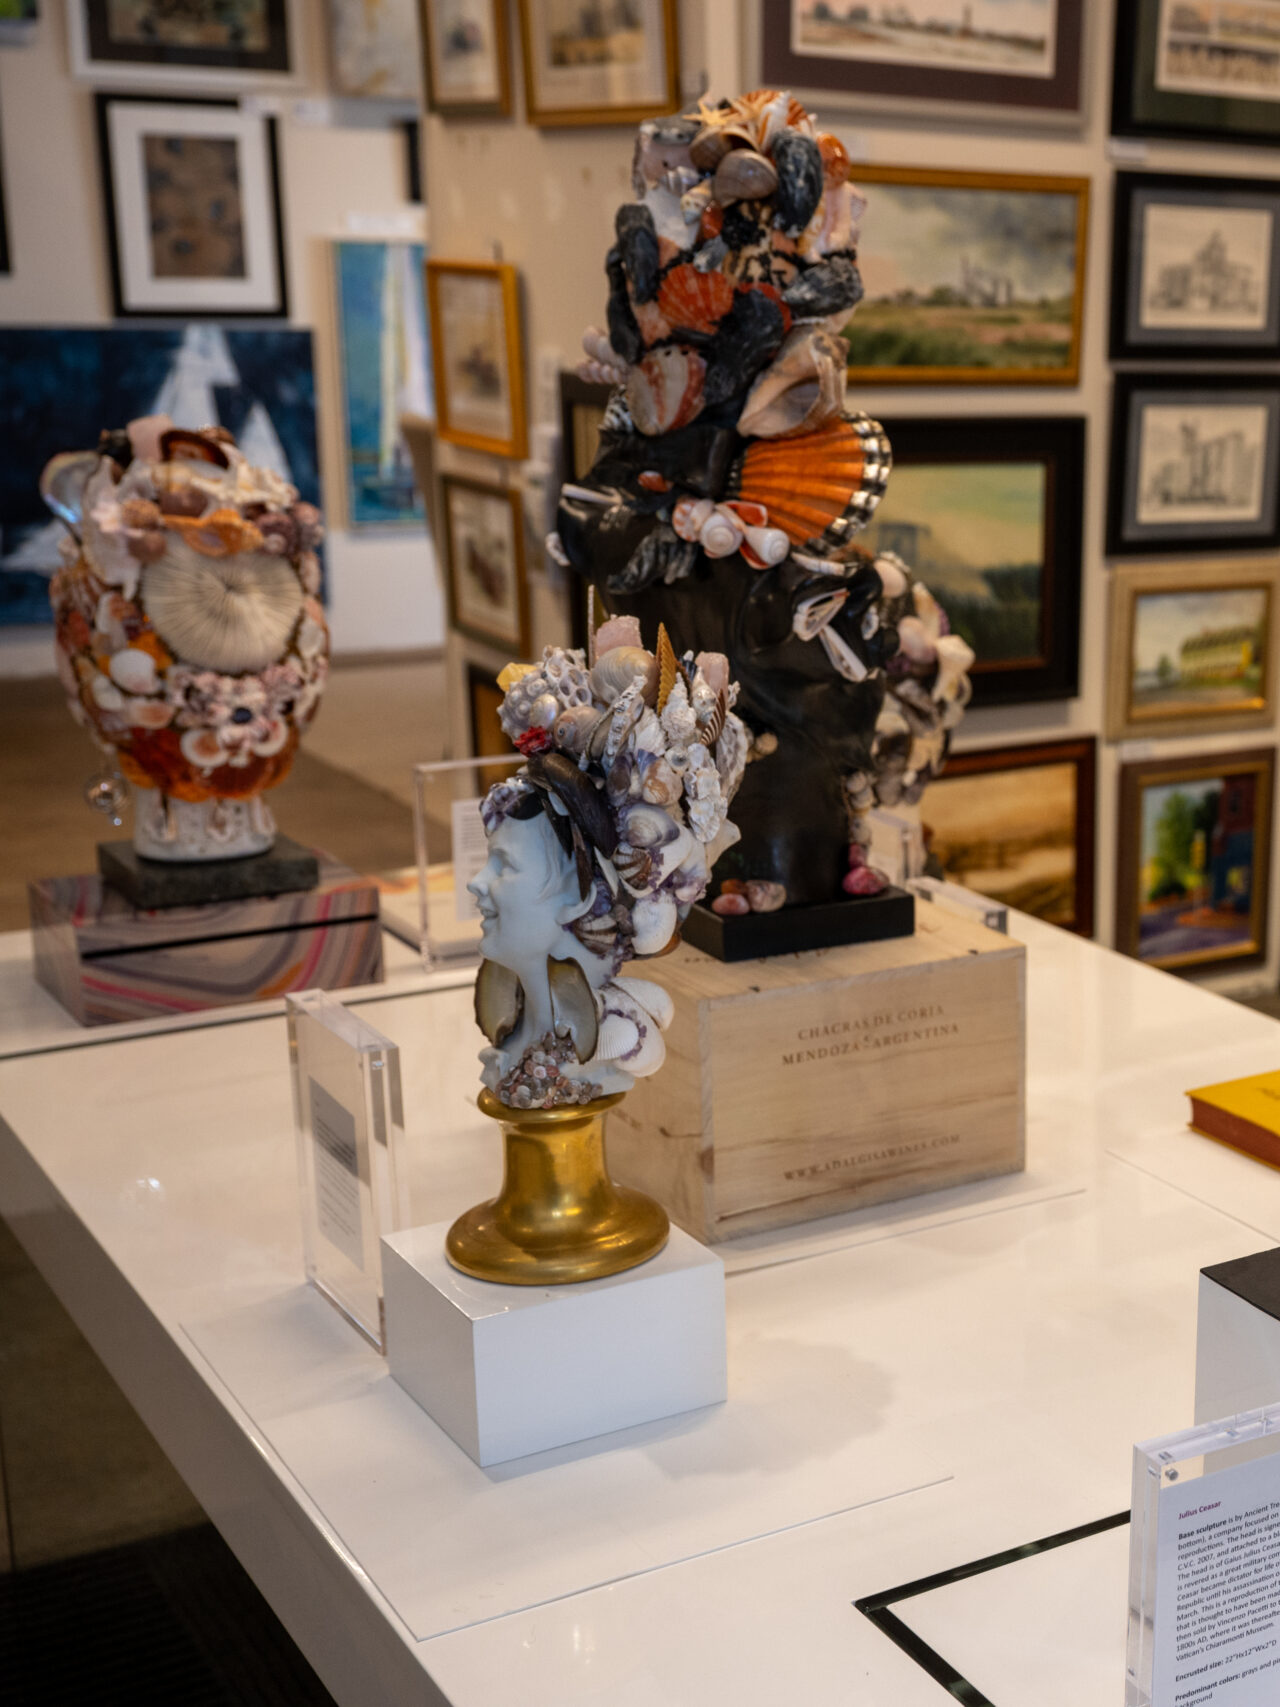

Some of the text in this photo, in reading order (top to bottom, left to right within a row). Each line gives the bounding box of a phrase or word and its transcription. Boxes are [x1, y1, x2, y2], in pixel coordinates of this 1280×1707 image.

[797, 1017, 870, 1041] CHACRAS
[873, 1013, 893, 1027] DE
[782, 1023, 959, 1066] MENDOZA ARGENTINA
[1178, 1500, 1222, 1520] Julius Ceasar
[1178, 1530, 1195, 1541] Base
[1195, 1519, 1227, 1535] sculpture
[1243, 1505, 1269, 1519] Ancient
[1213, 1524, 1244, 1539] company
[1244, 1513, 1270, 1529] focused
[1216, 1547, 1230, 1558] and
[1230, 1537, 1259, 1554] attached
[1226, 1535, 1240, 1544] The
[1239, 1527, 1257, 1540] head
[1176, 1589, 1200, 1602] Ceasar
[1200, 1580, 1227, 1594] became
[1227, 1570, 1253, 1584] dictator
[1253, 1566, 1264, 1575] for
[1264, 1562, 1275, 1572] life
[1177, 1572, 1191, 1582] The
[1191, 1564, 1208, 1577] head
[1223, 1554, 1243, 1566] Gaius
[1243, 1548, 1261, 1560] Julius
[1183, 1574, 1210, 1589] revered
[1224, 1564, 1242, 1577] great
[1242, 1555, 1268, 1569] military
[1176, 1597, 1205, 1612] Republic
[1205, 1590, 1222, 1602] until
[1221, 1587, 1232, 1596] his
[1232, 1573, 1275, 1592] assassination
[1201, 1604, 1215, 1614] This
[1227, 1584, 1269, 1604] reproduction
[1175, 1632, 1192, 1643] then
[1192, 1624, 1207, 1637] sold
[1216, 1612, 1247, 1627] Vincenzo
[1247, 1603, 1269, 1617] Pacetti
[1176, 1621, 1191, 1632] that
[1197, 1610, 1224, 1625] thought
[1233, 1601, 1249, 1612] have
[1249, 1595, 1267, 1606] been
[1176, 1640, 1196, 1653] 1800s
[1209, 1628, 1231, 1640] where
[1237, 1620, 1251, 1630] was
[1174, 1681, 1218, 1702] Predominant
[1218, 1673, 1241, 1686] colors:
[1241, 1666, 1259, 1679] grays
[1259, 1659, 1272, 1671] and
[1175, 1664, 1209, 1683] Encrusted
[1209, 1659, 1224, 1670] size:
